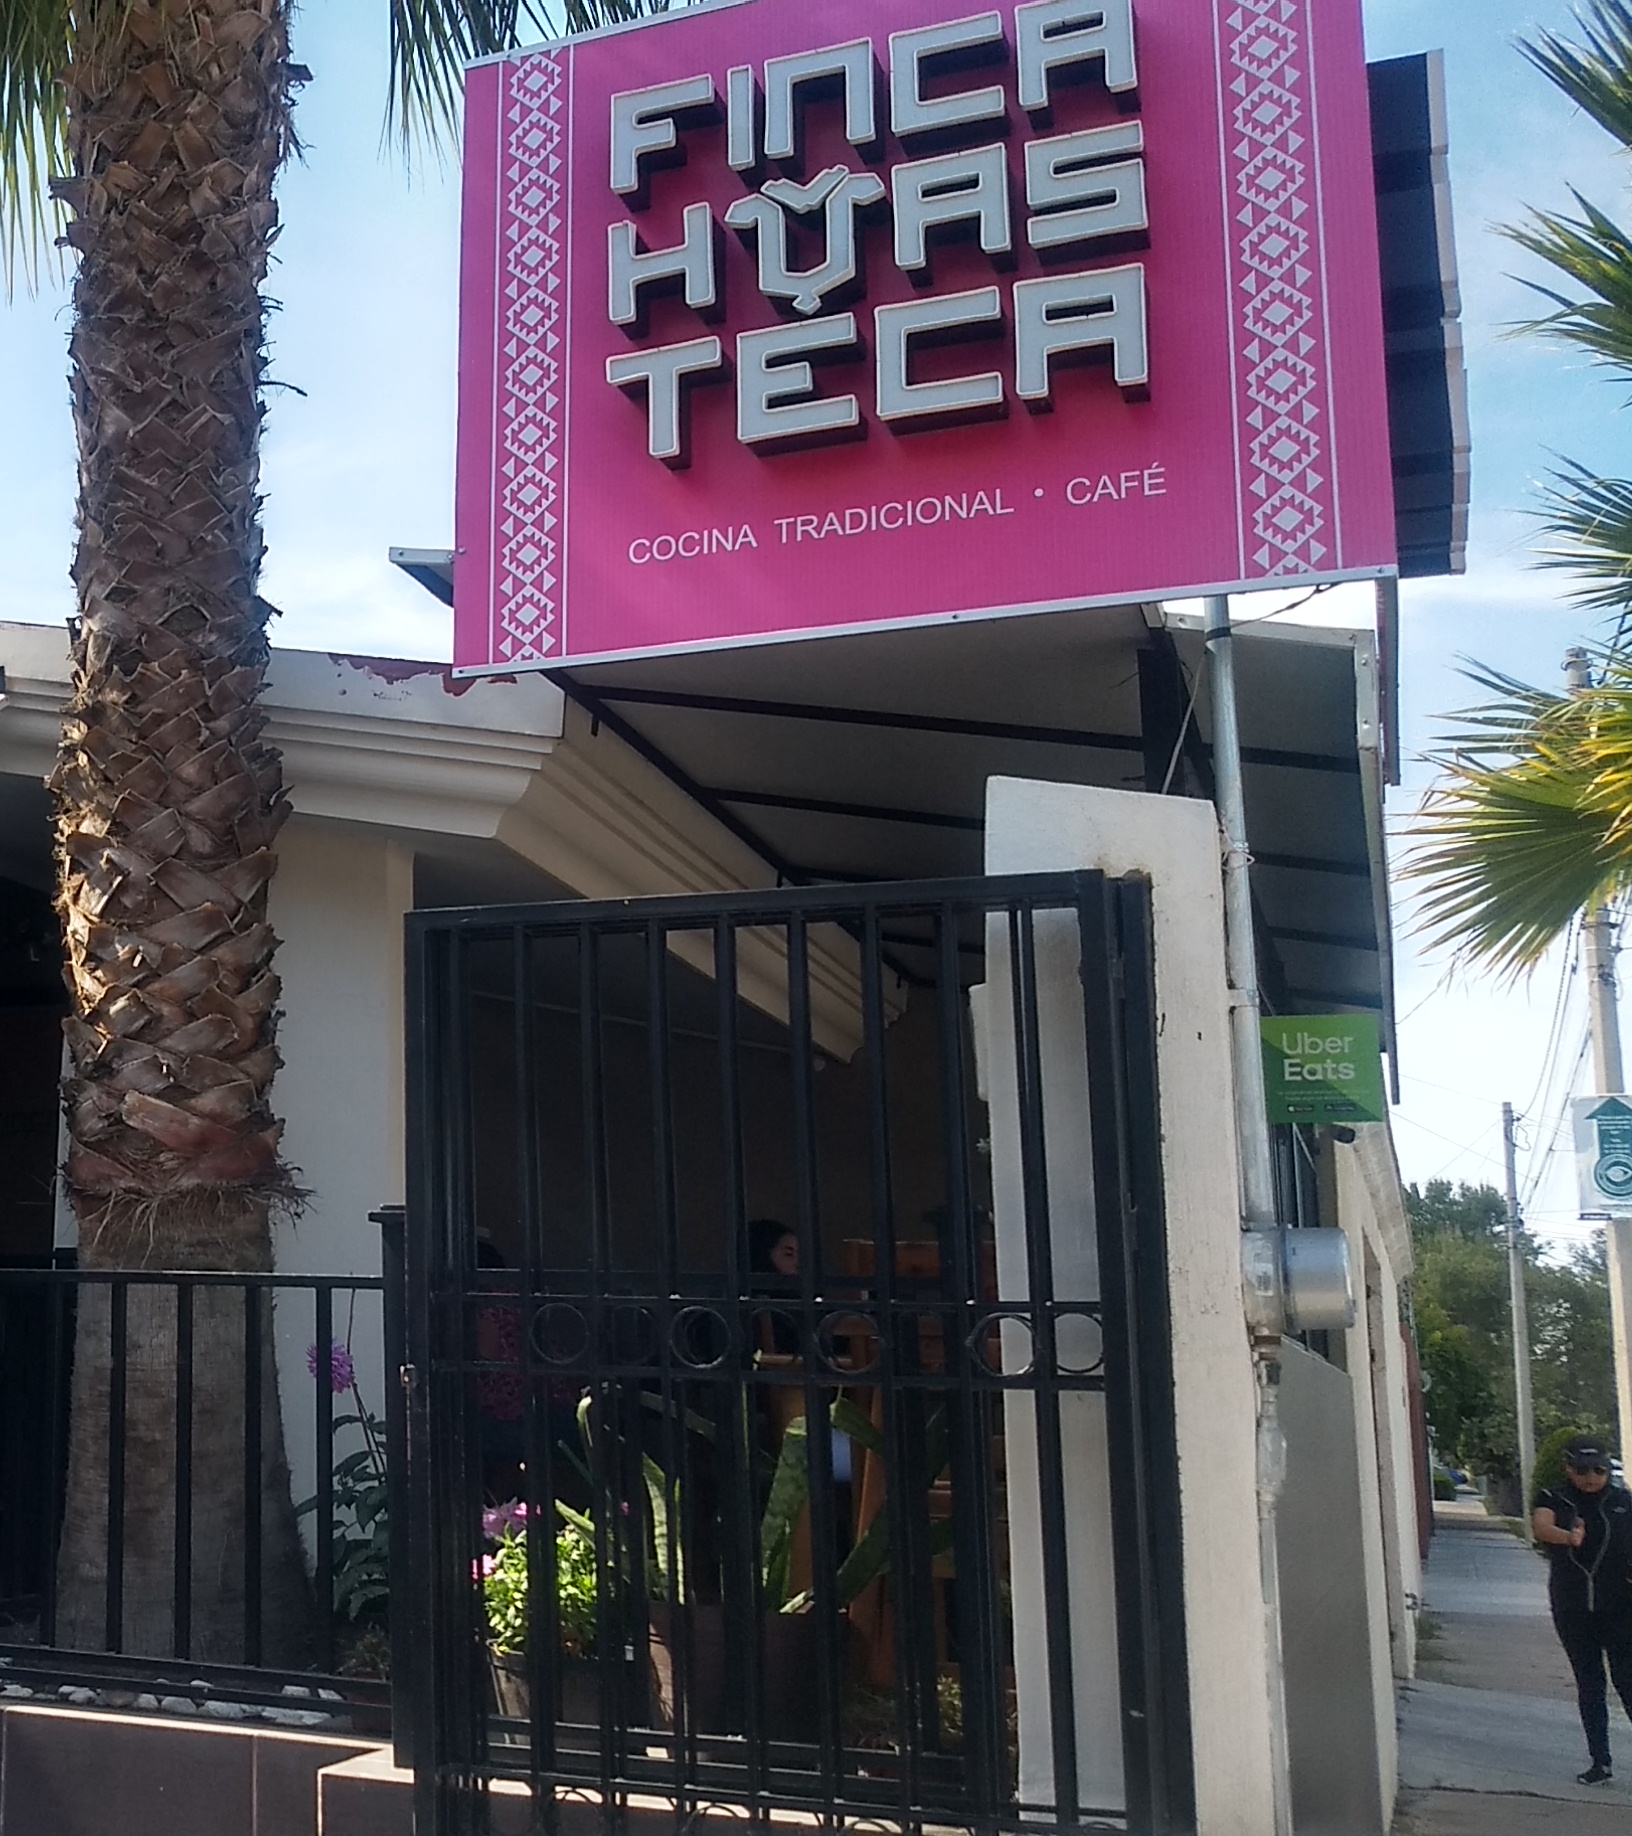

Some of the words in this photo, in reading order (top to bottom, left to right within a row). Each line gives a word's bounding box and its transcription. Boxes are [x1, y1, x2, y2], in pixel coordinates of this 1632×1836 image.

[609, 0, 1139, 195] FINCA
[607, 119, 1149, 325] HUAS
[605, 262, 1149, 460] TECA
[627, 523, 759, 564] COCINA
[773, 487, 1015, 544] TRADICIONAL
[1066, 461, 1168, 505] CAFÉ
[1281, 1031, 1355, 1055] Uber
[1282, 1058, 1356, 1081] Eats
